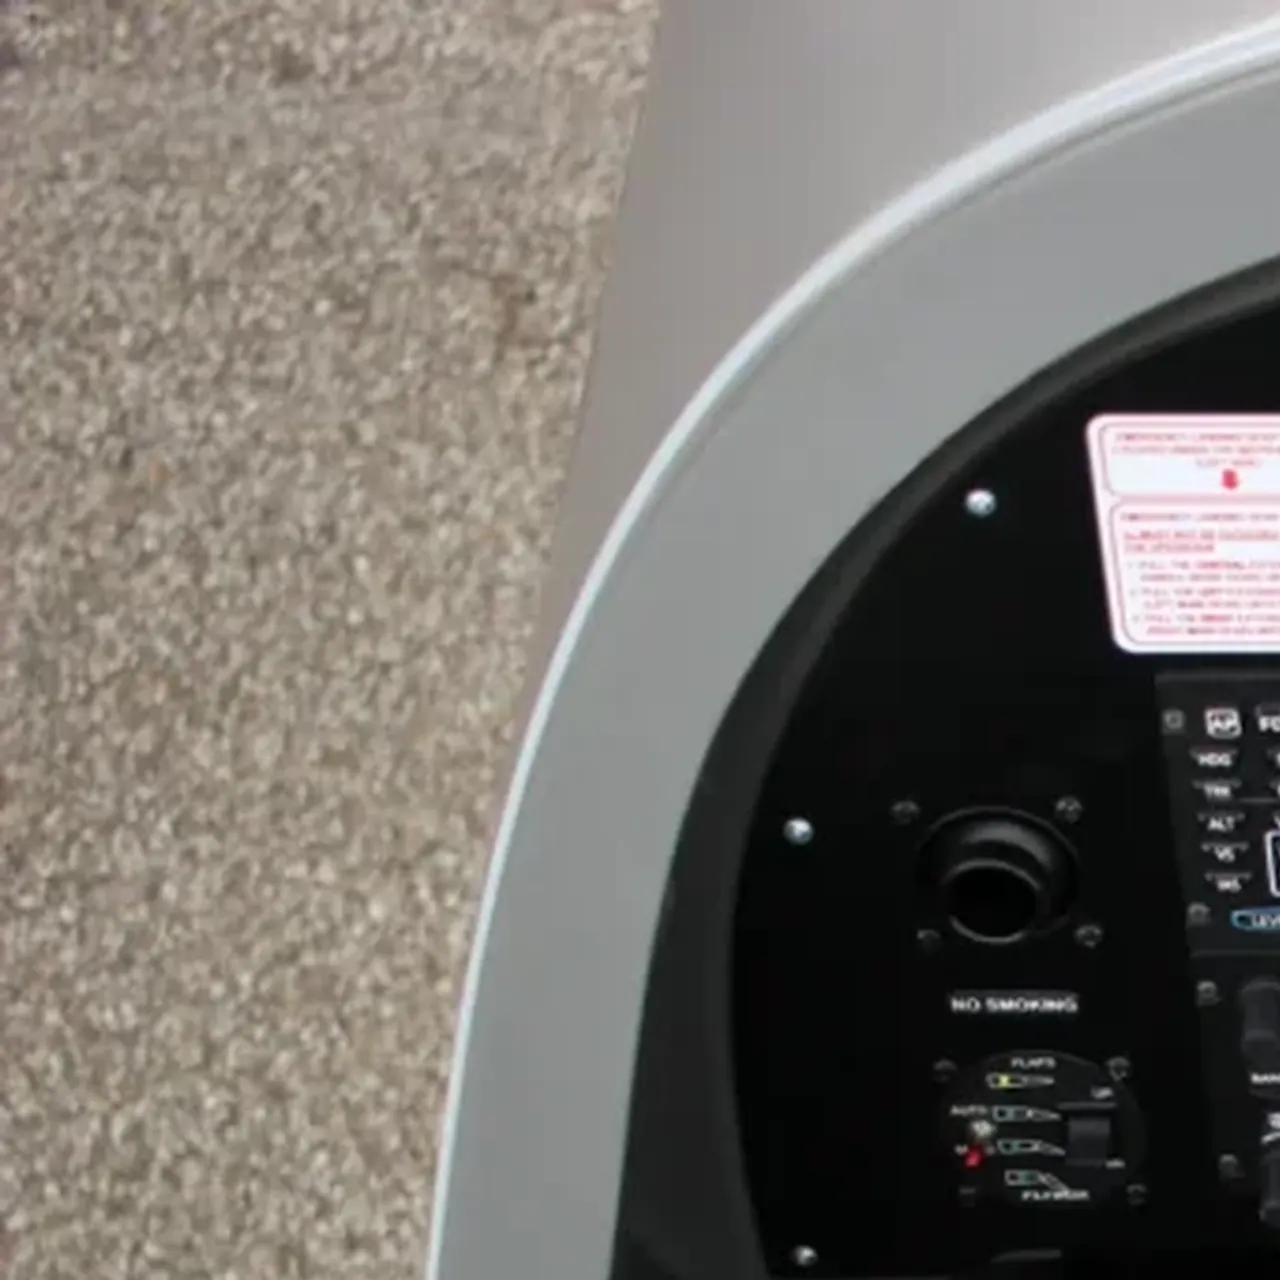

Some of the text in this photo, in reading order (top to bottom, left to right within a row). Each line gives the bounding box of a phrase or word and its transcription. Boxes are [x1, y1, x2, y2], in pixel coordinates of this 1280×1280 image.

[1198, 753, 1233, 767] HDG
[1208, 816, 1236, 831] ALT
[951, 995, 1080, 1014] NO SMOKING
[1010, 1056, 1057, 1069] FLAPS
